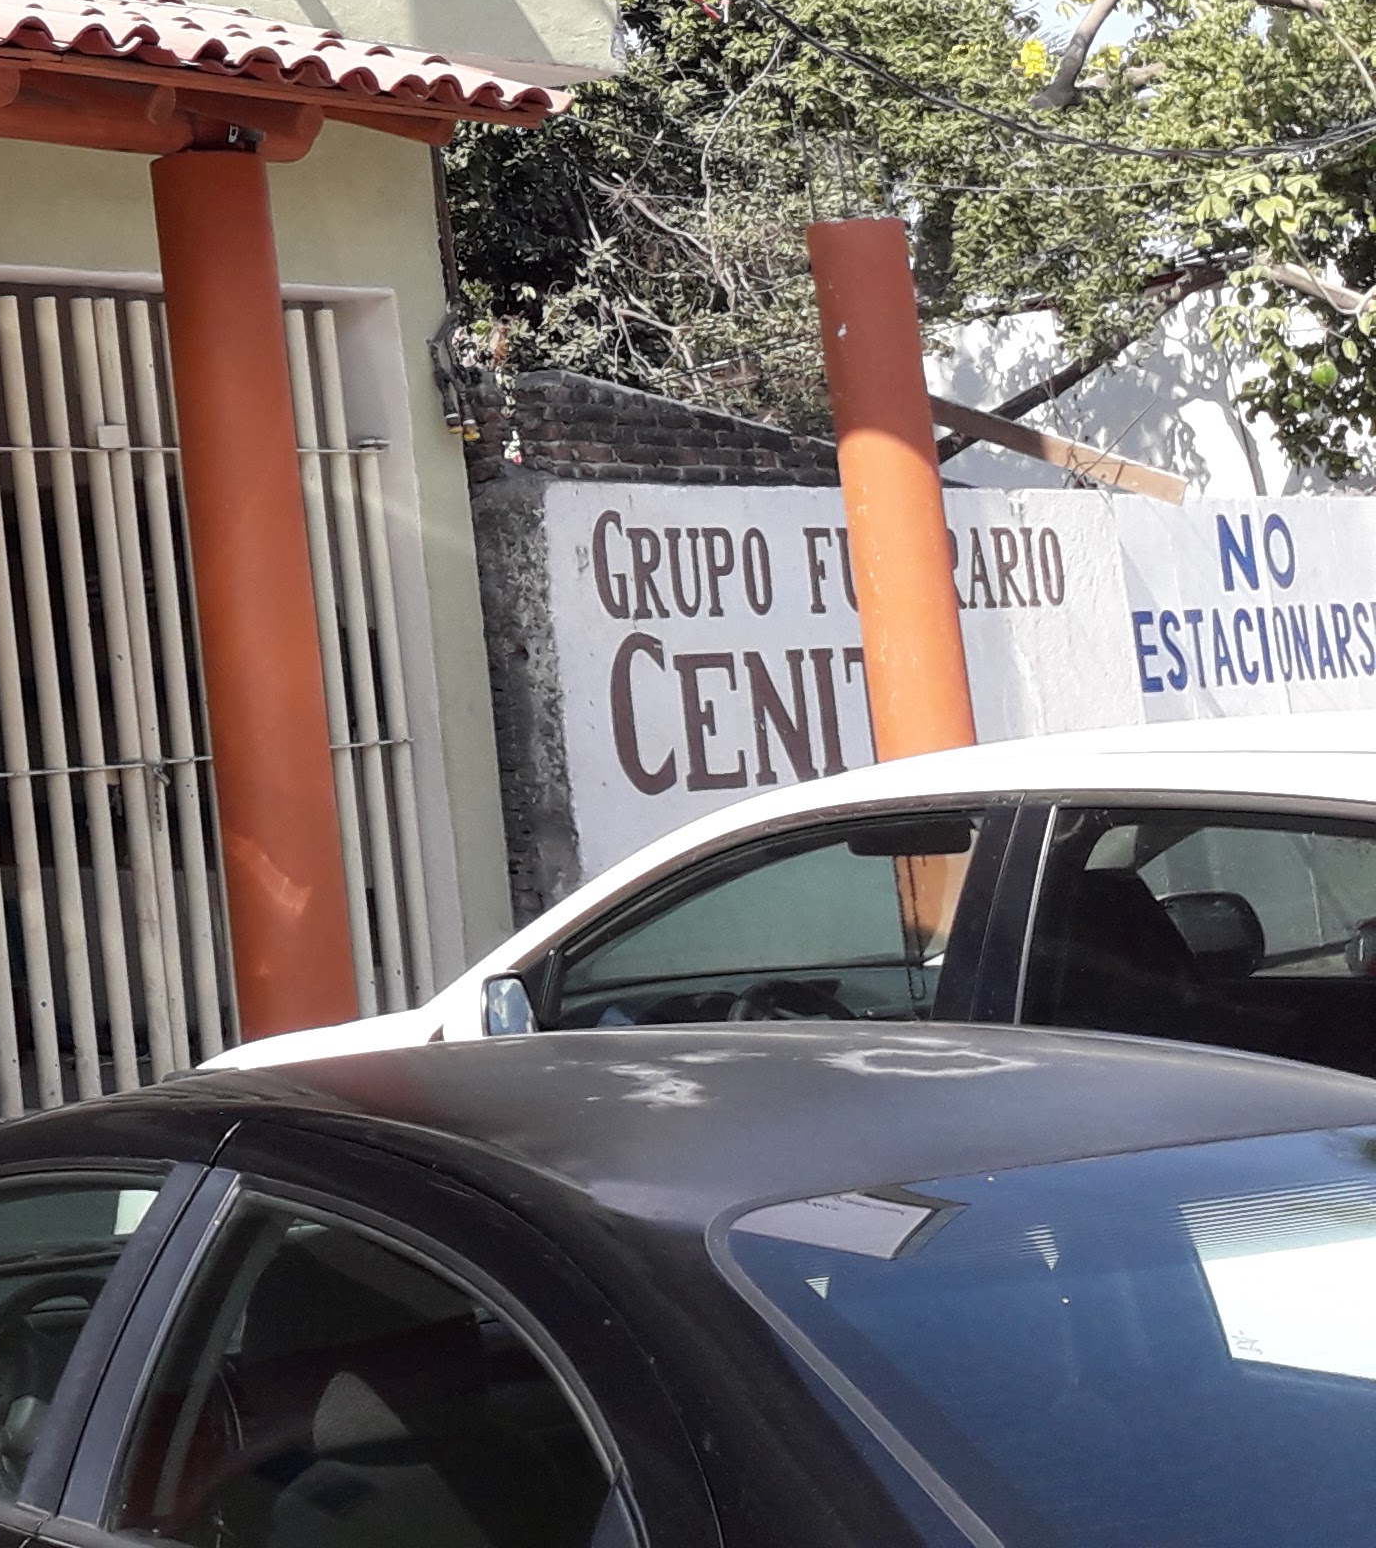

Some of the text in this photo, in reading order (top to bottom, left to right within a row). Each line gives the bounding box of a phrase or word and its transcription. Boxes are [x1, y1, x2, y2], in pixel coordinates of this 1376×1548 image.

[591, 509, 773, 620] GRUPO
[1215, 513, 1297, 592] NO
[1132, 601, 1376, 693] ESTACIONARS
